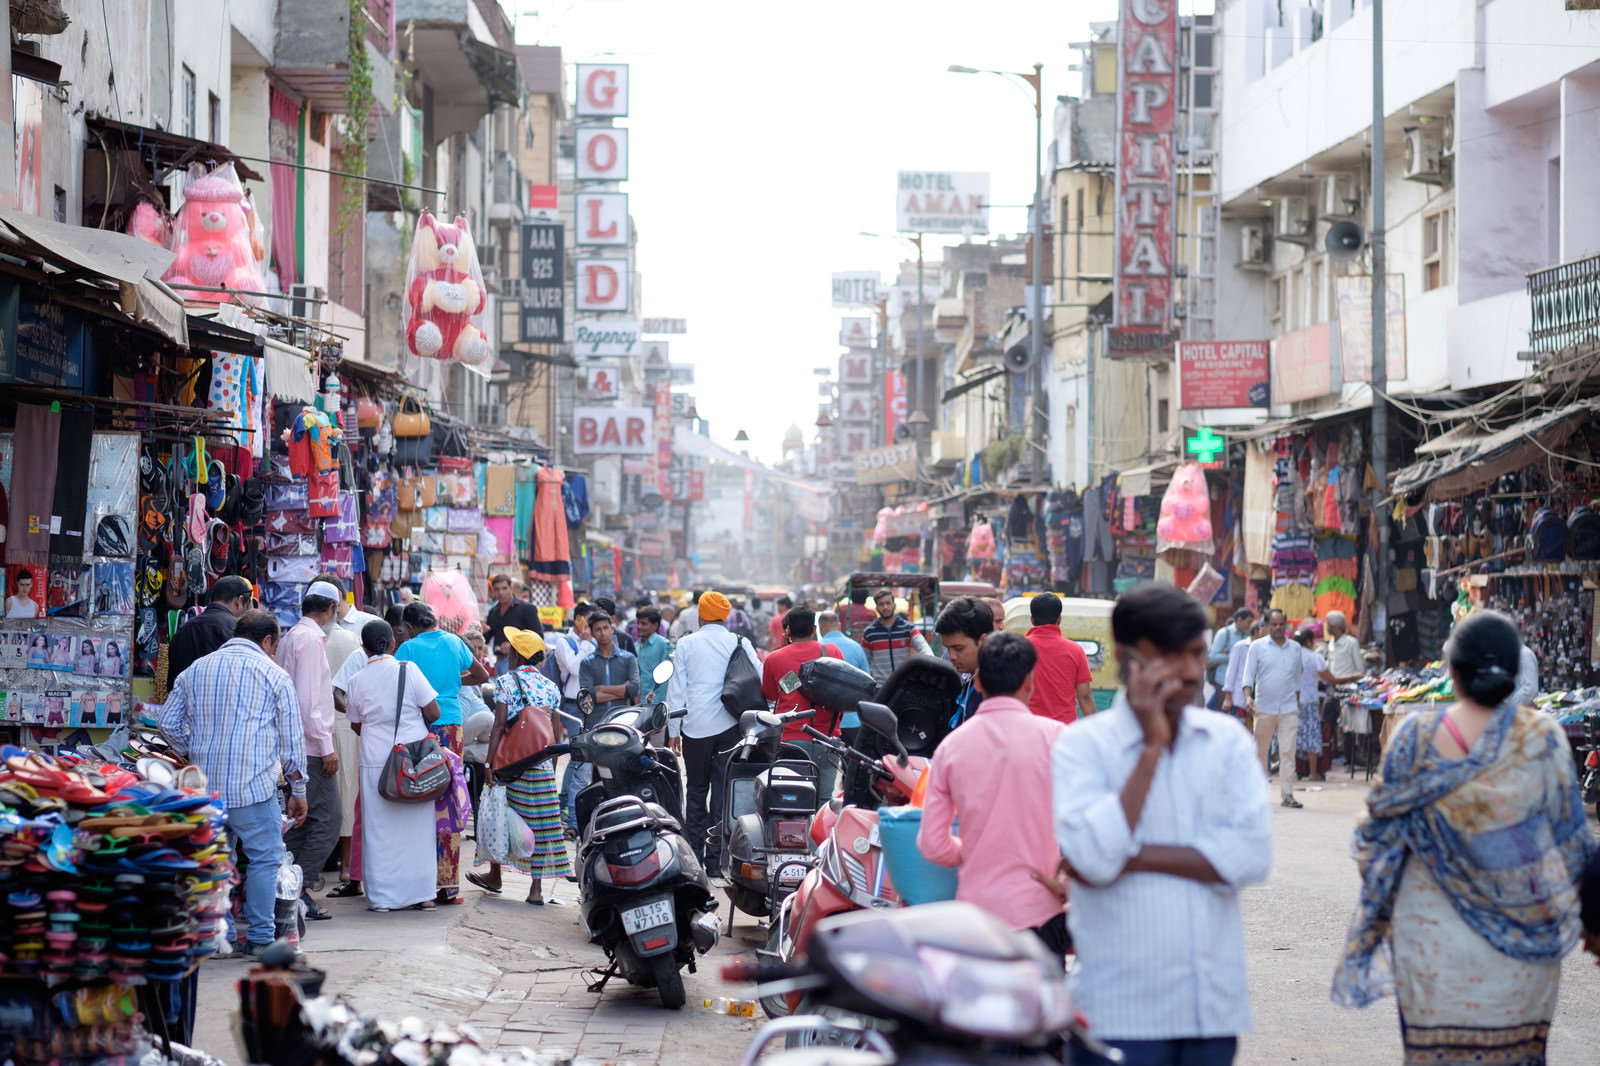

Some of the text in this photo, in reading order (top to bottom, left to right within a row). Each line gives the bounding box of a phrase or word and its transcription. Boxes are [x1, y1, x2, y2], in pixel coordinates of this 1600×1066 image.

[1125, 0, 1172, 326] CAPITAL
[585, 69, 618, 304] GOLD
[900, 173, 955, 191] HOTEL
[530, 229, 555, 249] AAA
[532, 258, 553, 279] 925
[524, 288, 562, 308] SILVER
[832, 279, 877, 300] HOTEL
[527, 317, 558, 338] INDIA
[576, 326, 637, 352] Regency
[1183, 343, 1264, 360] HOTEL CAPITAL
[594, 371, 612, 392] &
[578, 417, 645, 446] BAR
[634, 903, 663, 919] DL1S
